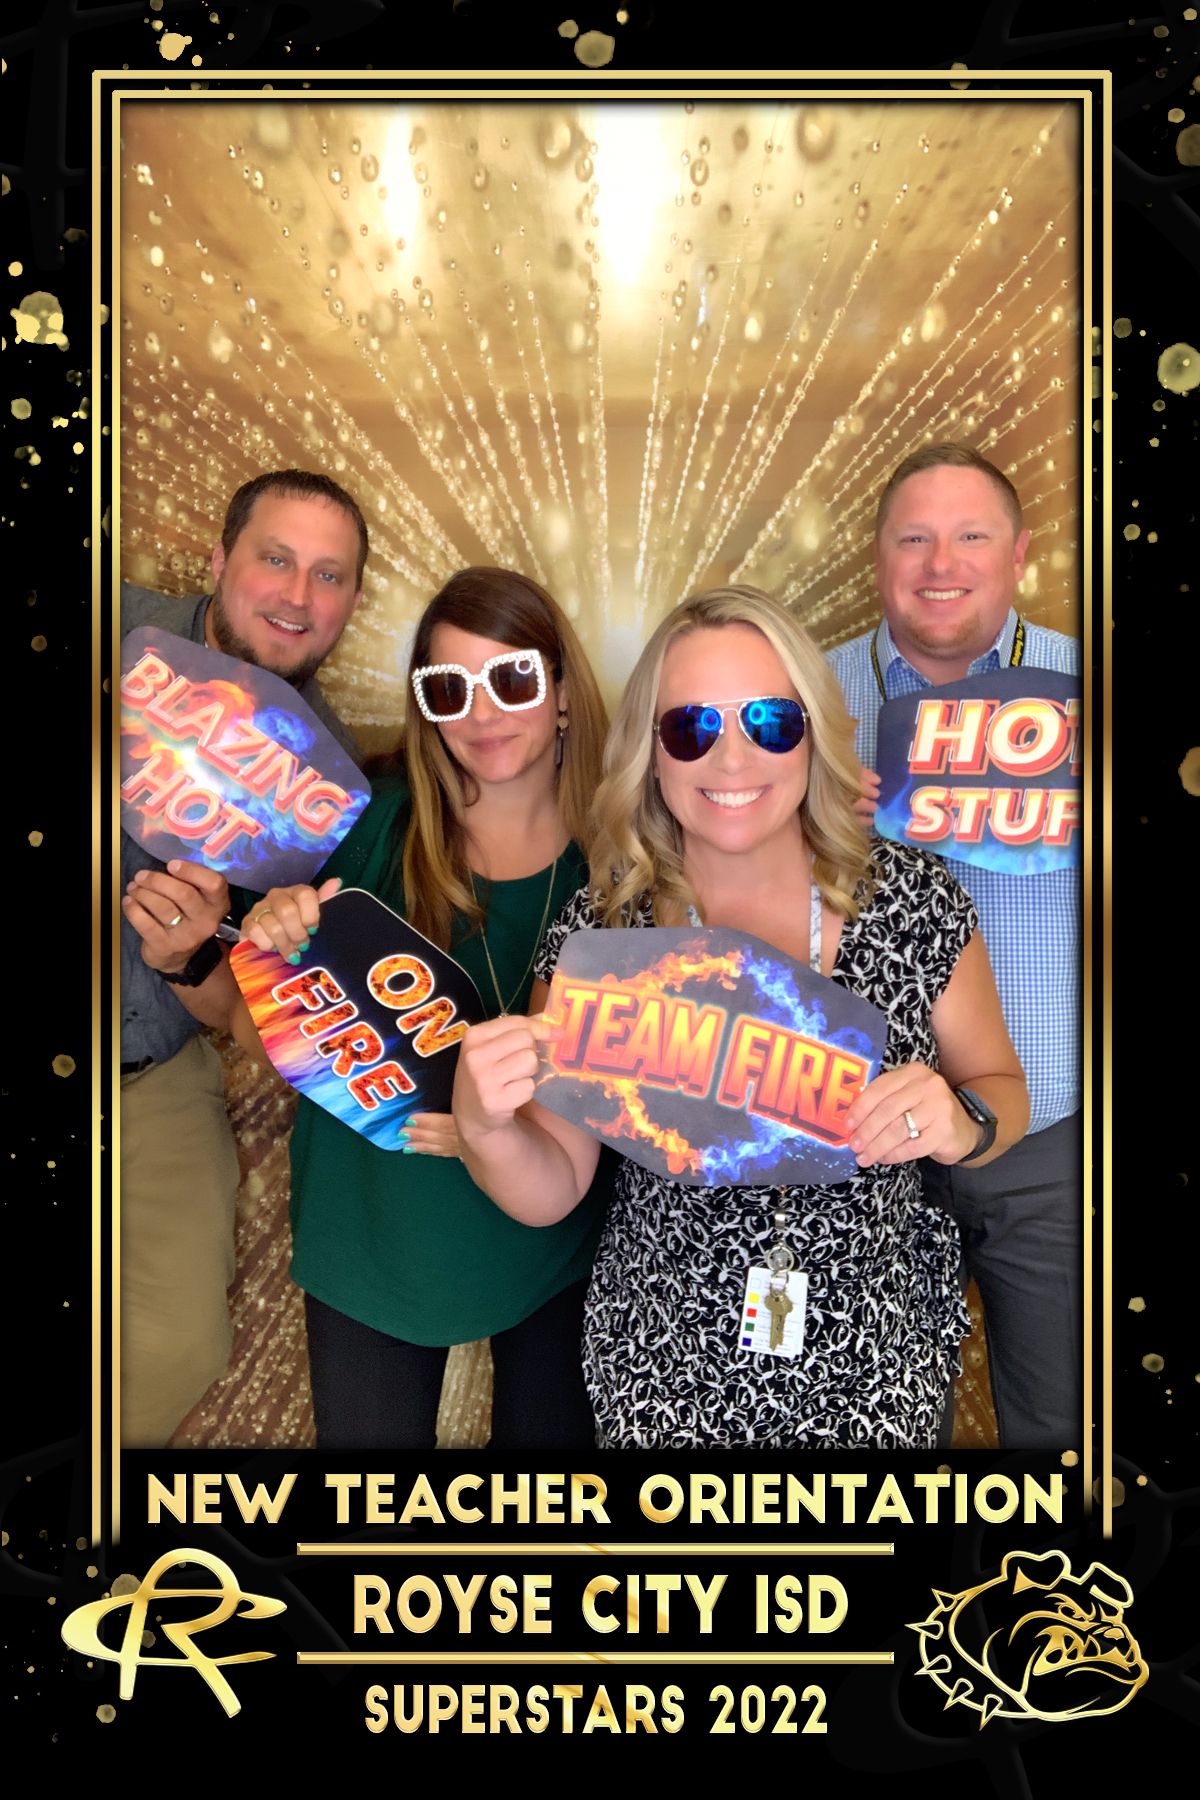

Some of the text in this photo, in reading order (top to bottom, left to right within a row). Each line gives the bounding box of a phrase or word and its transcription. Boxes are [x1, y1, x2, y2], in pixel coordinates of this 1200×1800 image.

[120, 653, 353, 836] BLAZING
[121, 754, 265, 858] HOT
[272, 966, 416, 1111] FIRE
[367, 954, 470, 1058] ON
[552, 983, 872, 1147] TEAM FIRE
